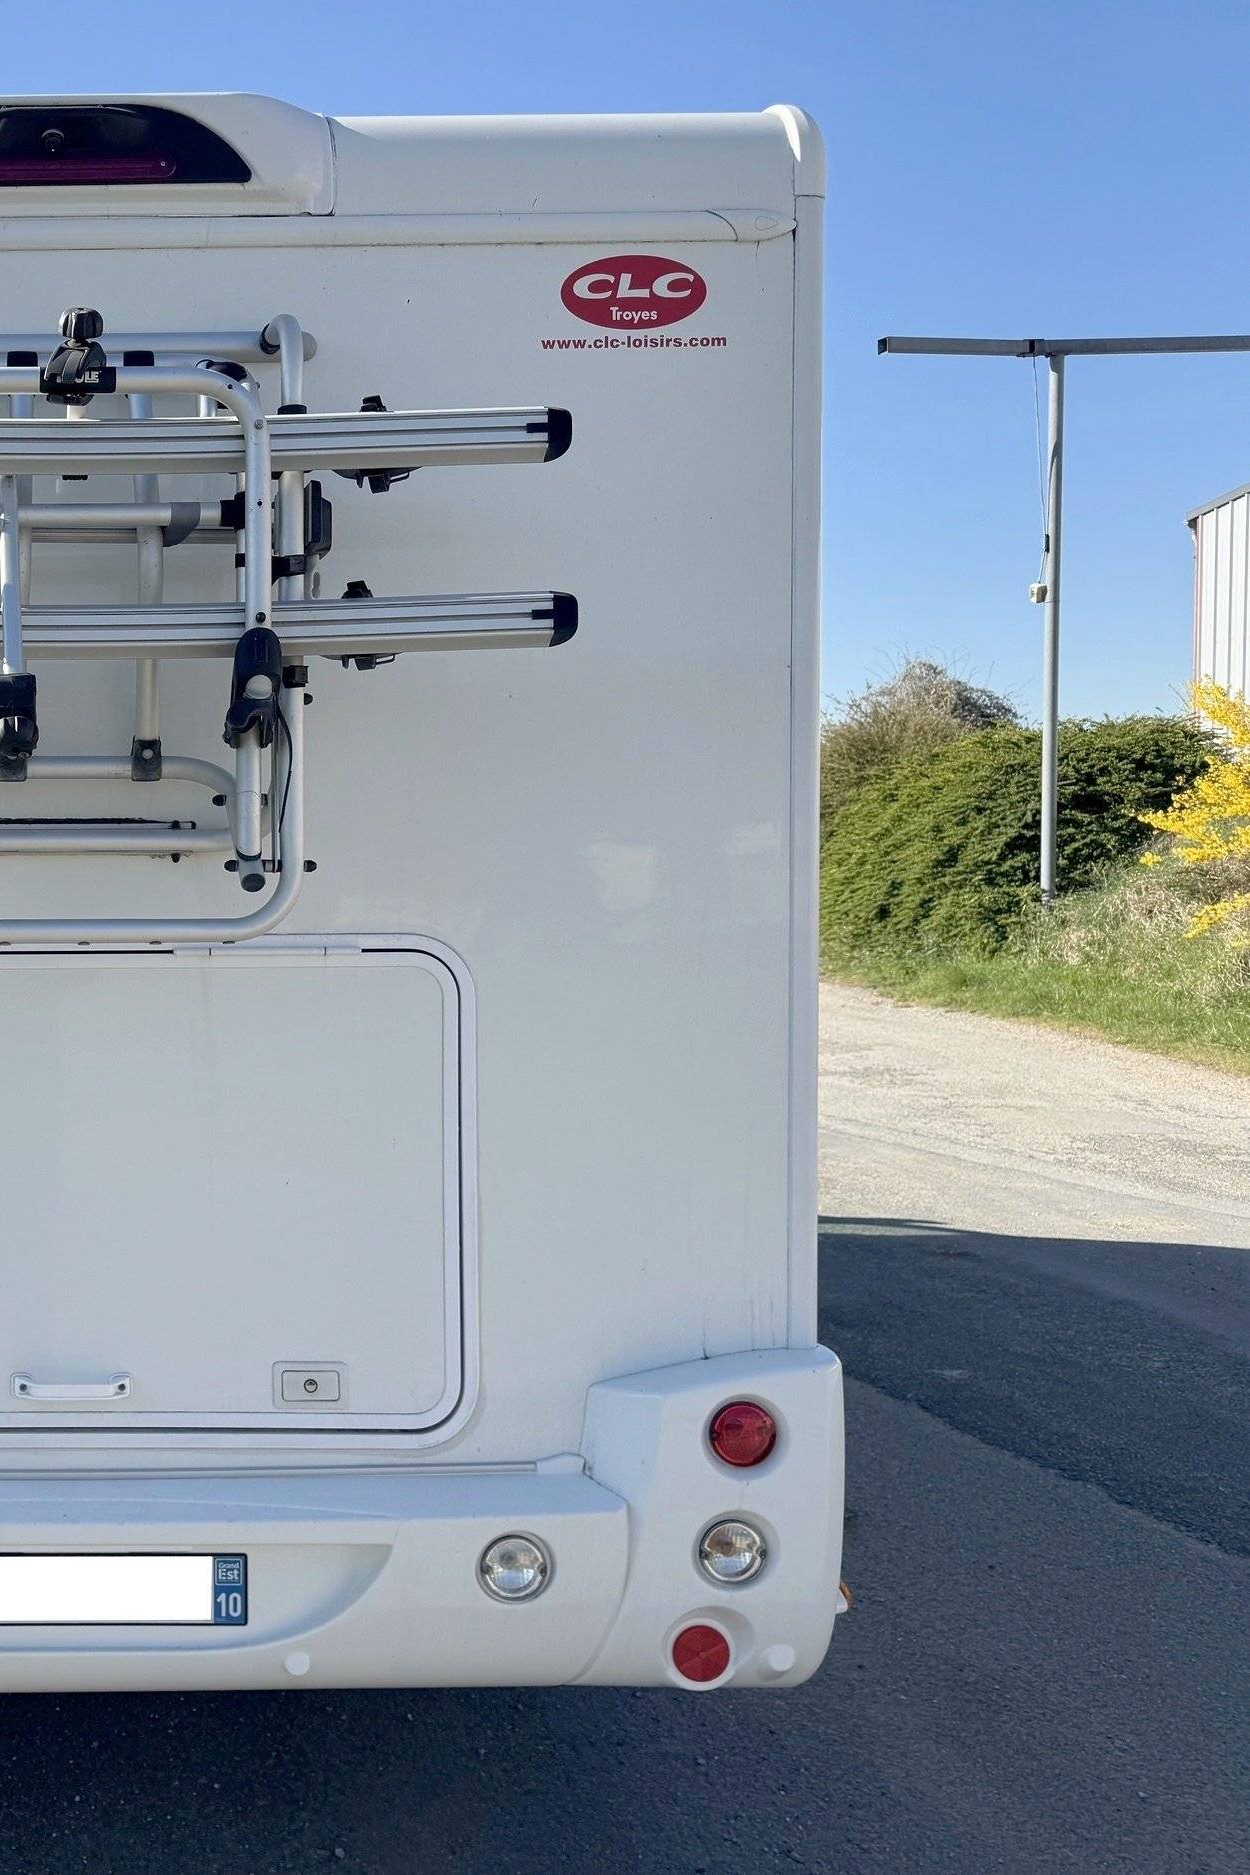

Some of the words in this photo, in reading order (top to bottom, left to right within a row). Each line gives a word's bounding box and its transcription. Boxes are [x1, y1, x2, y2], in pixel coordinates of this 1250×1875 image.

[573, 272, 694, 299] CLC
[610, 306, 658, 323] Troyes
[541, 335, 727, 350] www.clc-loisirs.com
[56, 371, 100, 384] ULE
[218, 1569, 239, 1580] Est
[217, 1592, 241, 1617] 10
